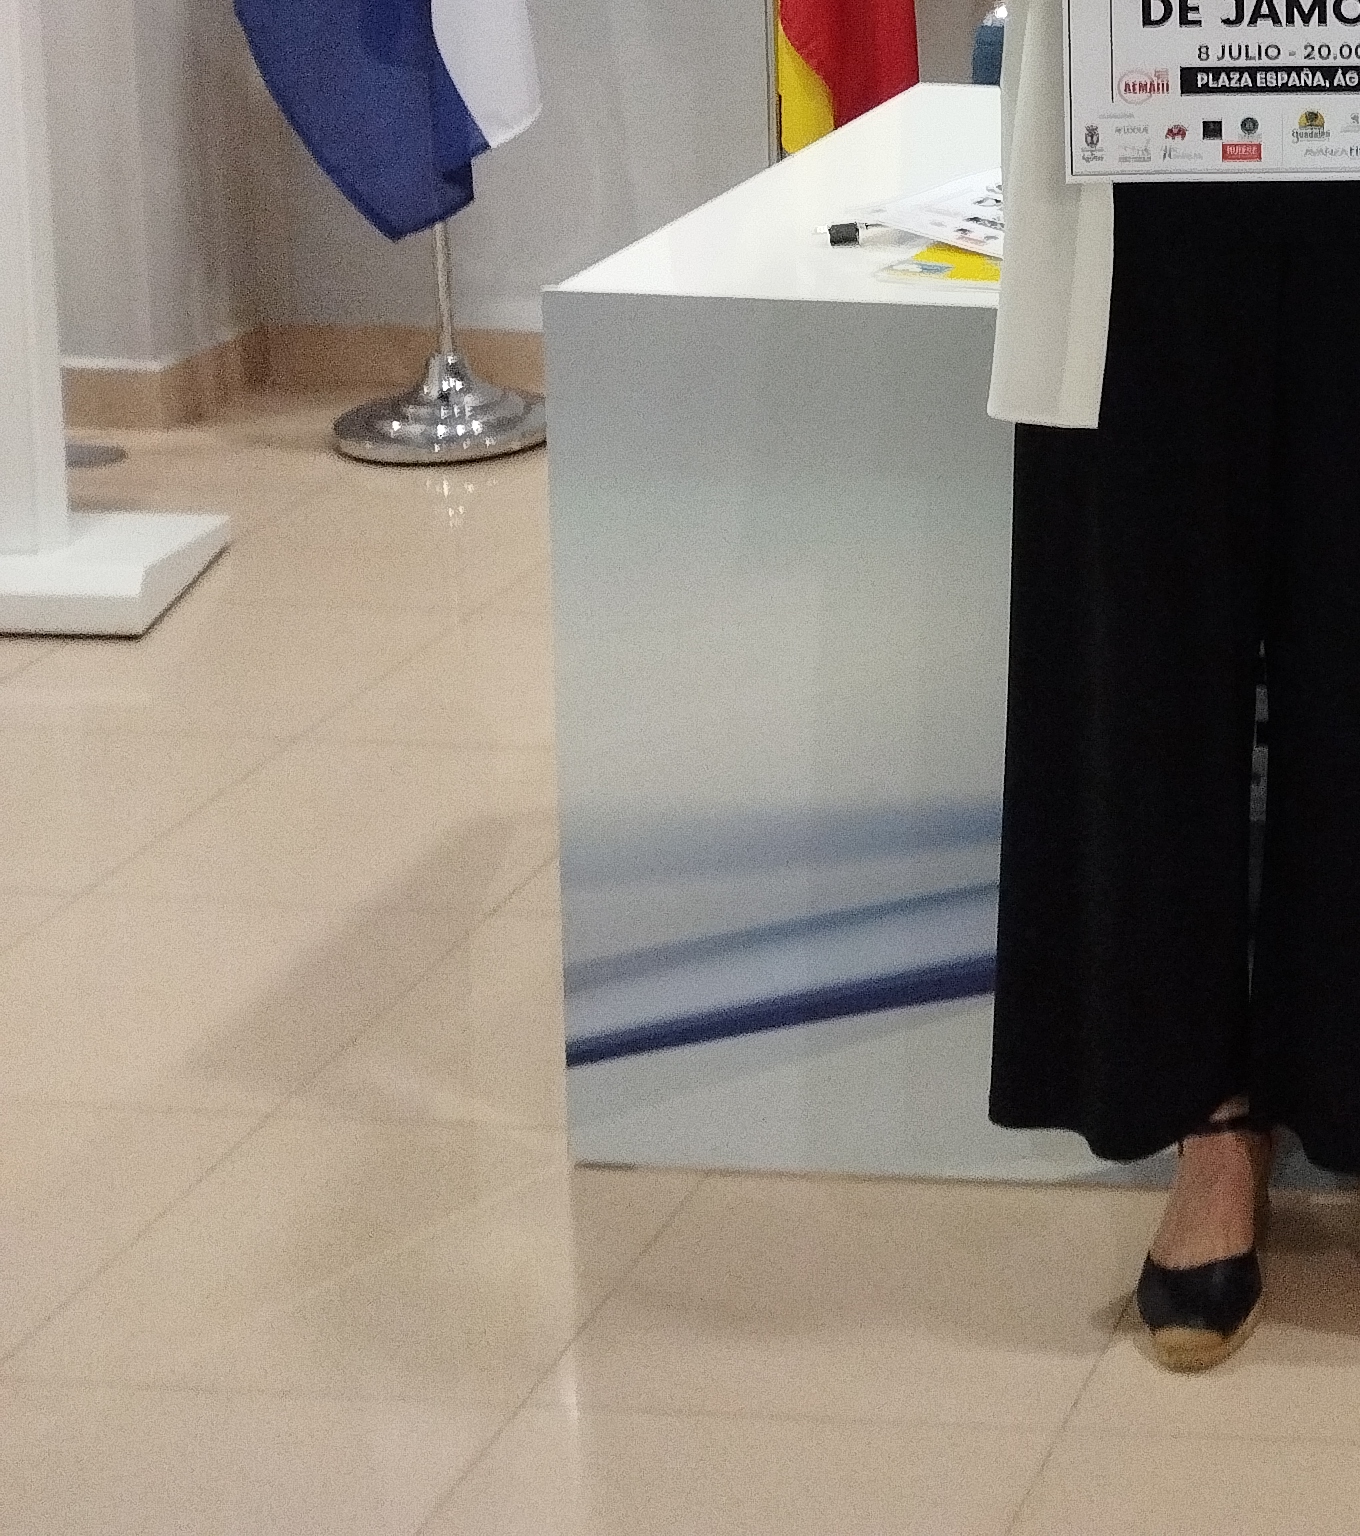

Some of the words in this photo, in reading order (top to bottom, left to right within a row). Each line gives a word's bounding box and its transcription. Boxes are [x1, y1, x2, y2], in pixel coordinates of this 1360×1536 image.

[1197, 44, 1209, 62] 8
[1215, 44, 1281, 62] JULIO
[1197, 72, 1252, 88] PLAZA
[1256, 68, 1330, 89] ESPAÑA,
